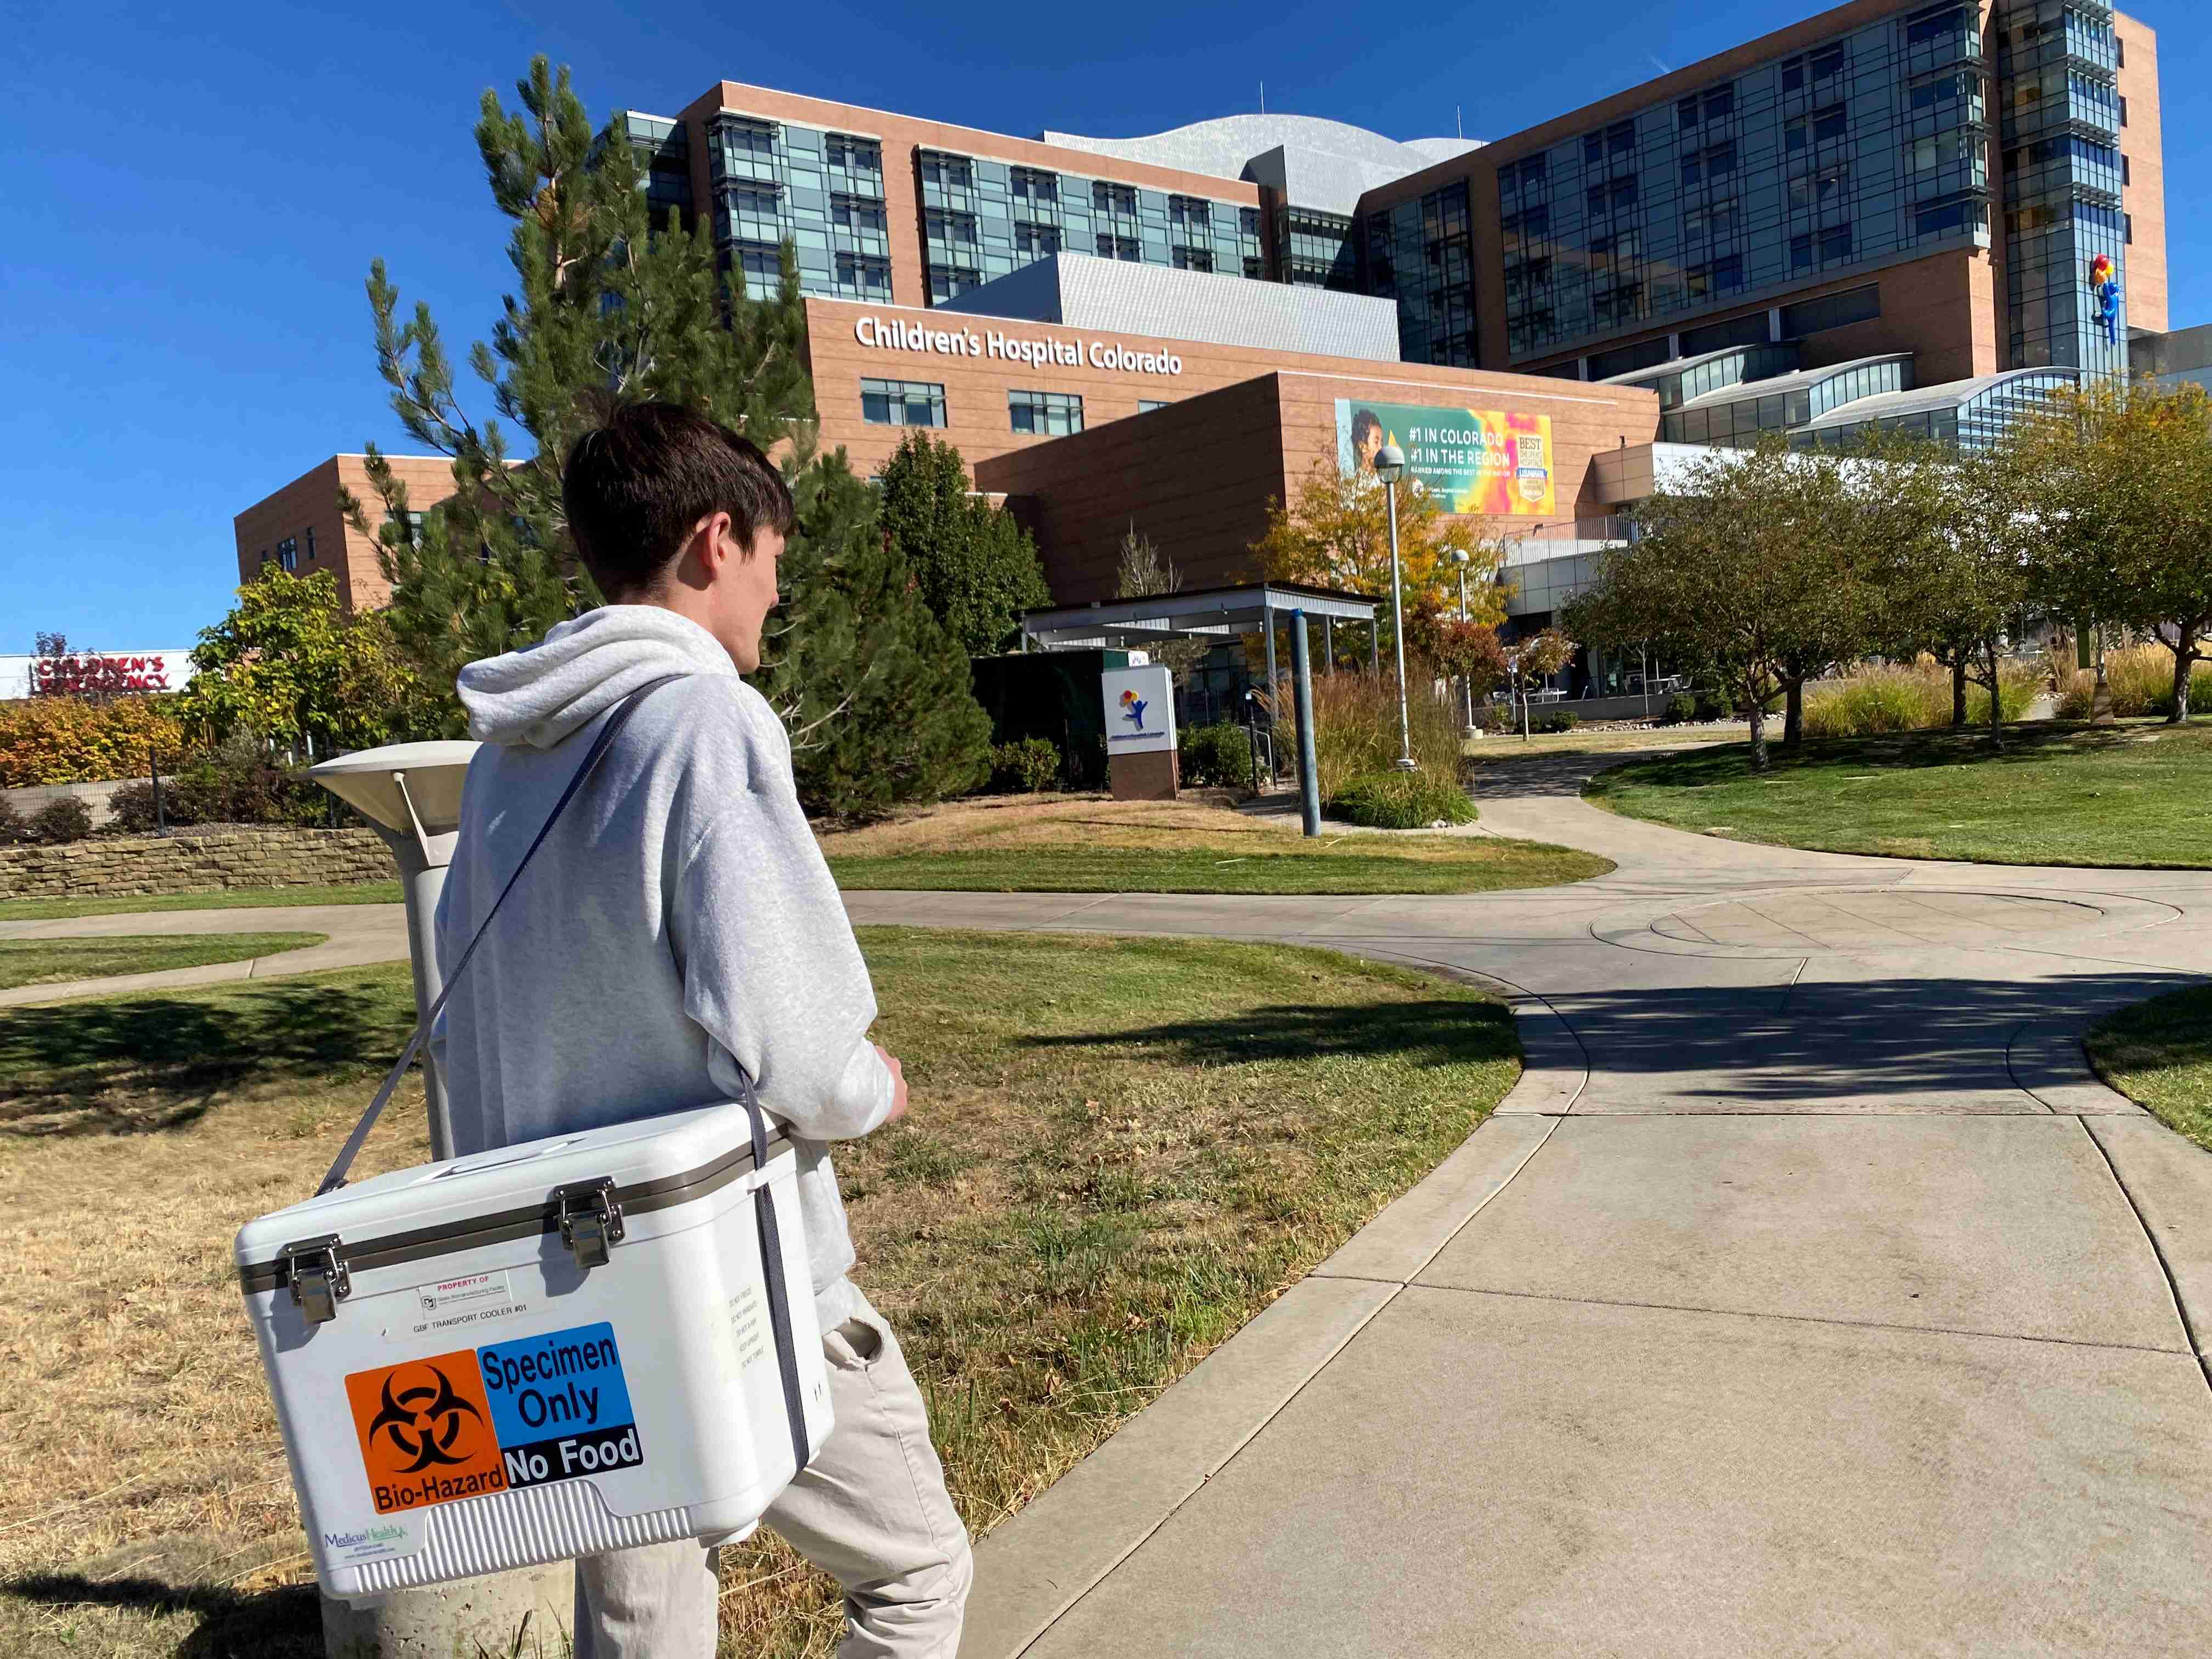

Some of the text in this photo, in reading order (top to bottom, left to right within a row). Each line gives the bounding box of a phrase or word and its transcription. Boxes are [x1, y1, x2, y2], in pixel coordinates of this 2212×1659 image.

[855, 317, 1183, 375] Children's Hospital Colorado
[1409, 427, 1503, 447] #1 IN COLORADO
[1519, 437, 1541, 450] BEST
[1410, 448, 1422, 462] #1
[1426, 448, 1438, 464] IN
[1441, 449, 1464, 465] THE
[1467, 450, 1510, 468] REGION
[438, 1278, 477, 1291] PROPERTY
[413, 1304, 527, 1333] GBF TRANSPORT COOLER #01
[482, 1337, 617, 1395] Specimen
[518, 1381, 599, 1429] Only
[504, 1429, 641, 1485] No Food
[375, 1464, 504, 1511] Bio-Hazard
